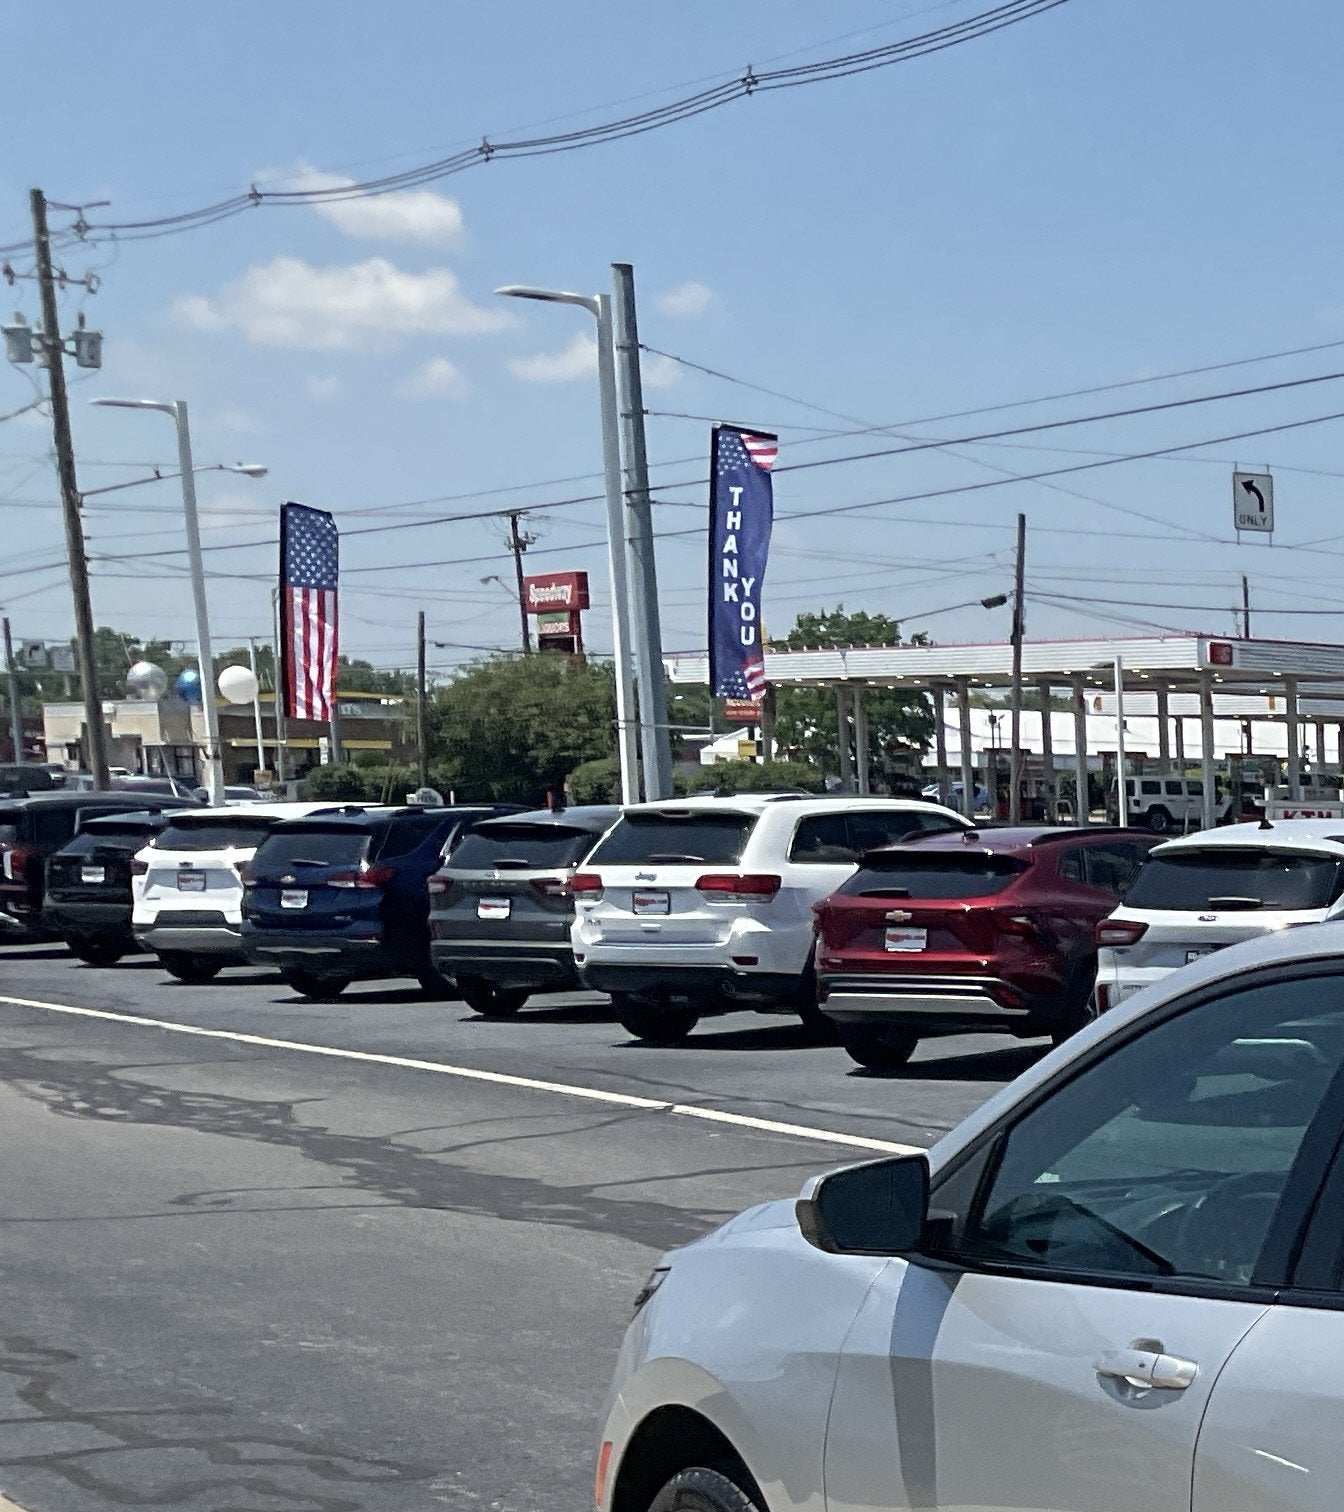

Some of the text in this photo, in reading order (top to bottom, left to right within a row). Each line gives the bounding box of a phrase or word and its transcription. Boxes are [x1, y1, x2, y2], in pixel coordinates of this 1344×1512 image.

[722, 486, 743, 603] THANK
[1239, 514, 1267, 527] ONLY
[740, 577, 756, 646] YOU
